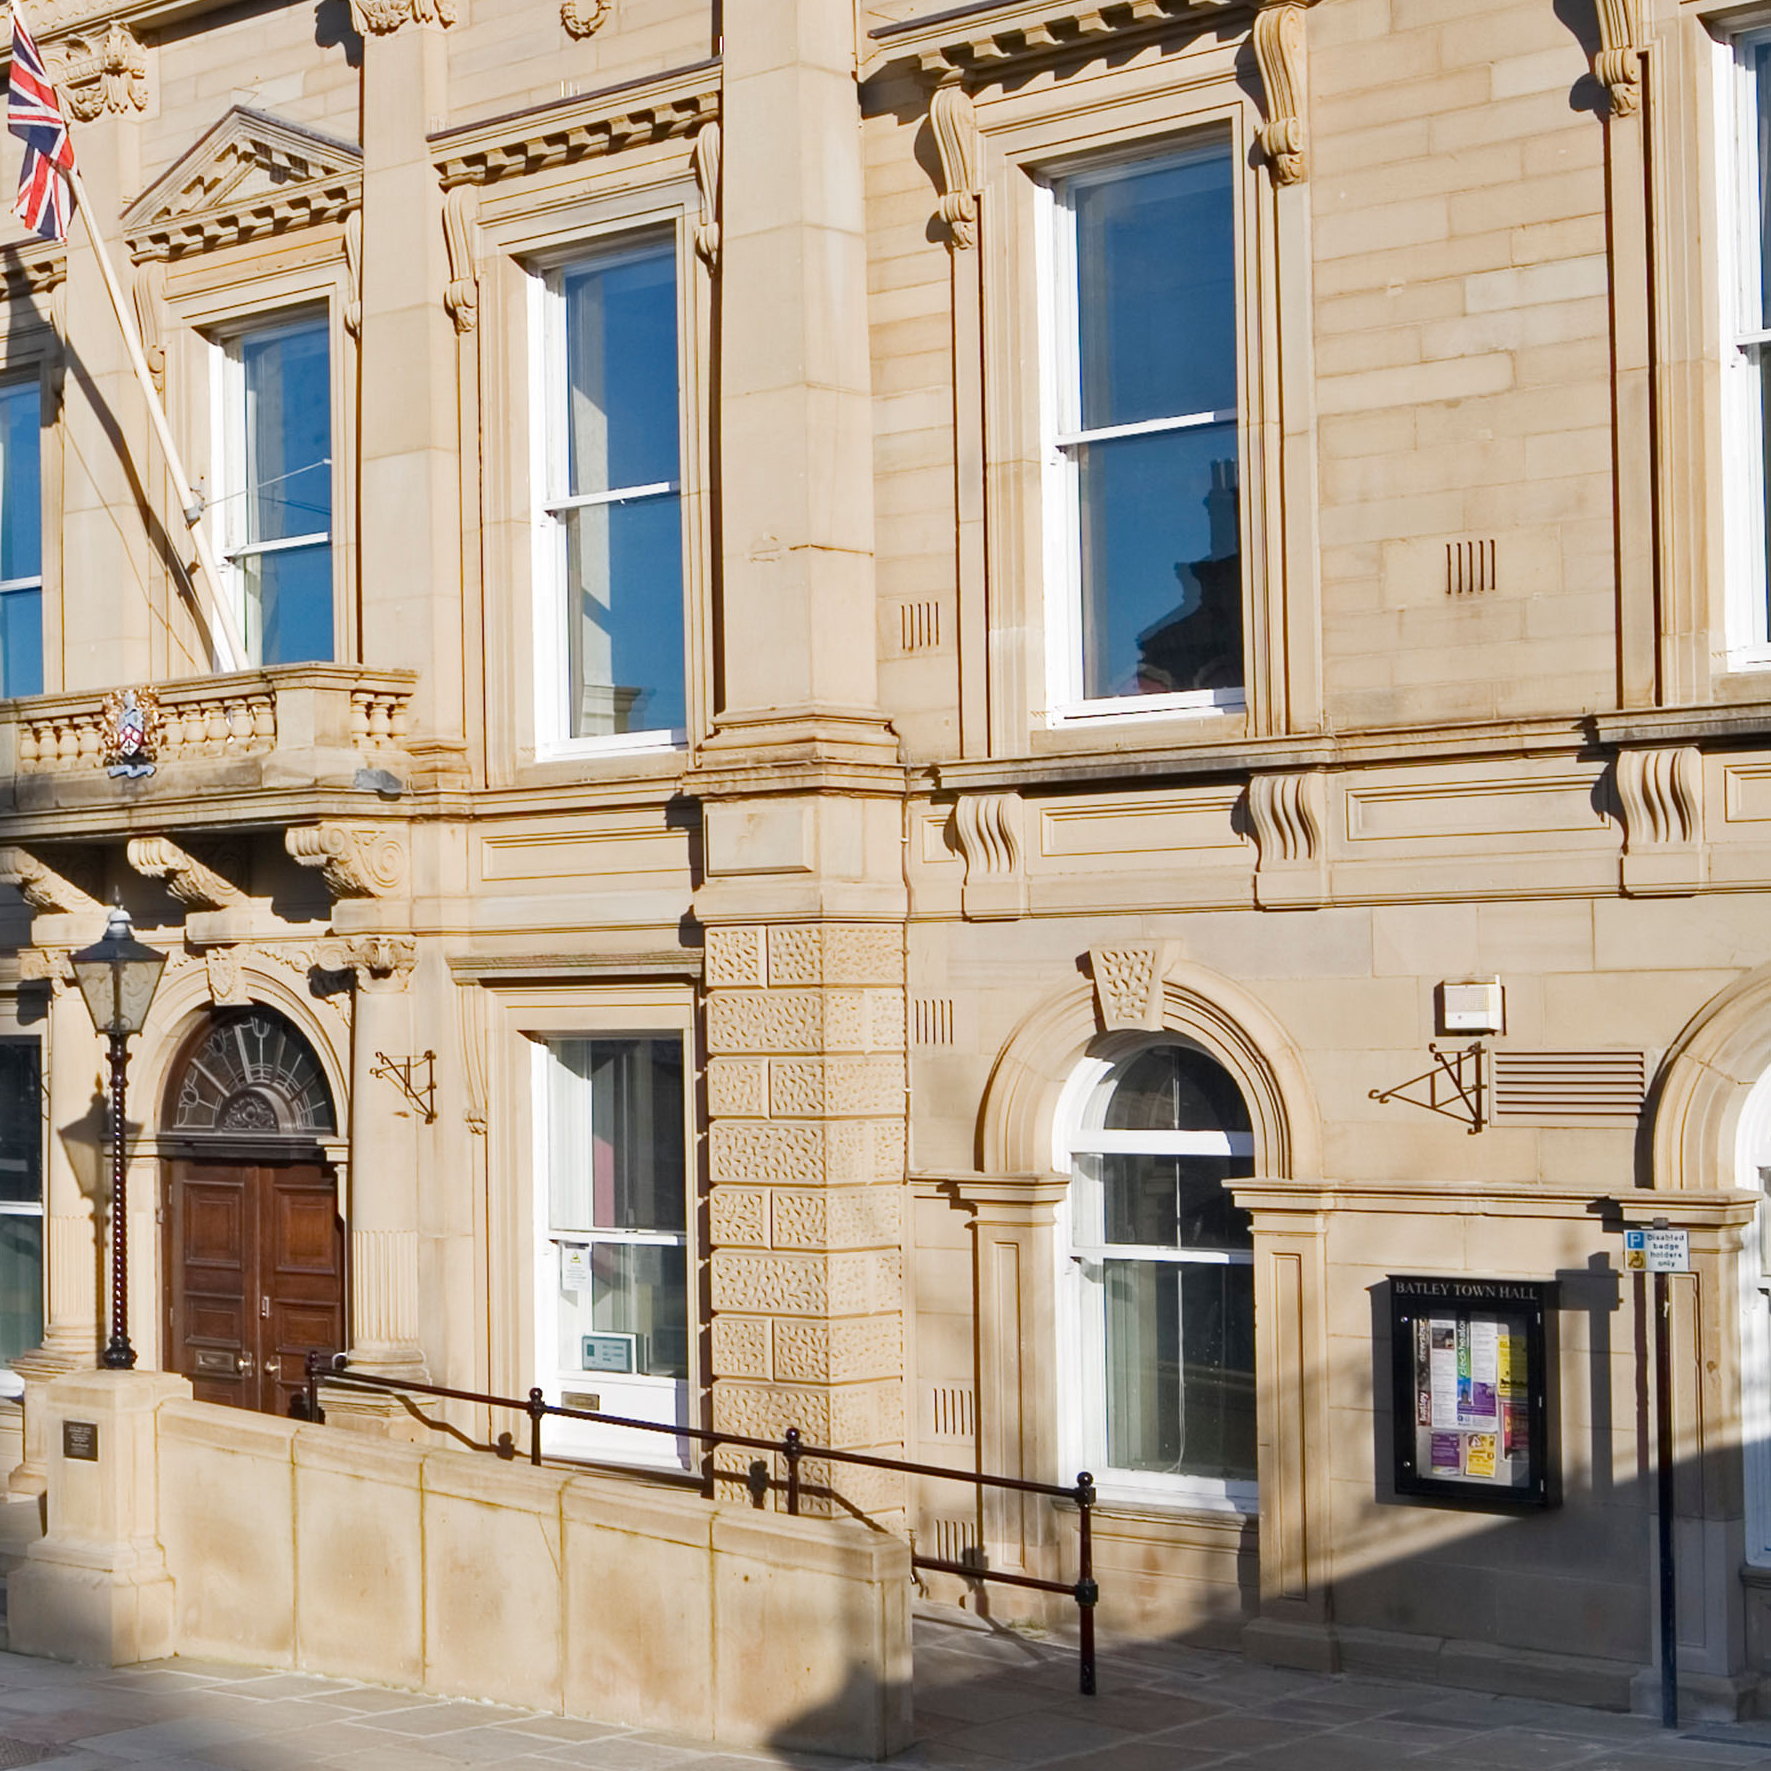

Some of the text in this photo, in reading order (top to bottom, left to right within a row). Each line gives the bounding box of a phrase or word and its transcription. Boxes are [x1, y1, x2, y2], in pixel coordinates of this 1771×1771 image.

[1647, 1233, 1684, 1241] Disabled
[1653, 1242, 1679, 1251] badge
[1650, 1251, 1682, 1259] holders
[1658, 1260, 1675, 1268] only
[1395, 1281, 1538, 1300] BATLEY TOWN HALL
[1418, 1392, 1429, 1422] batley
